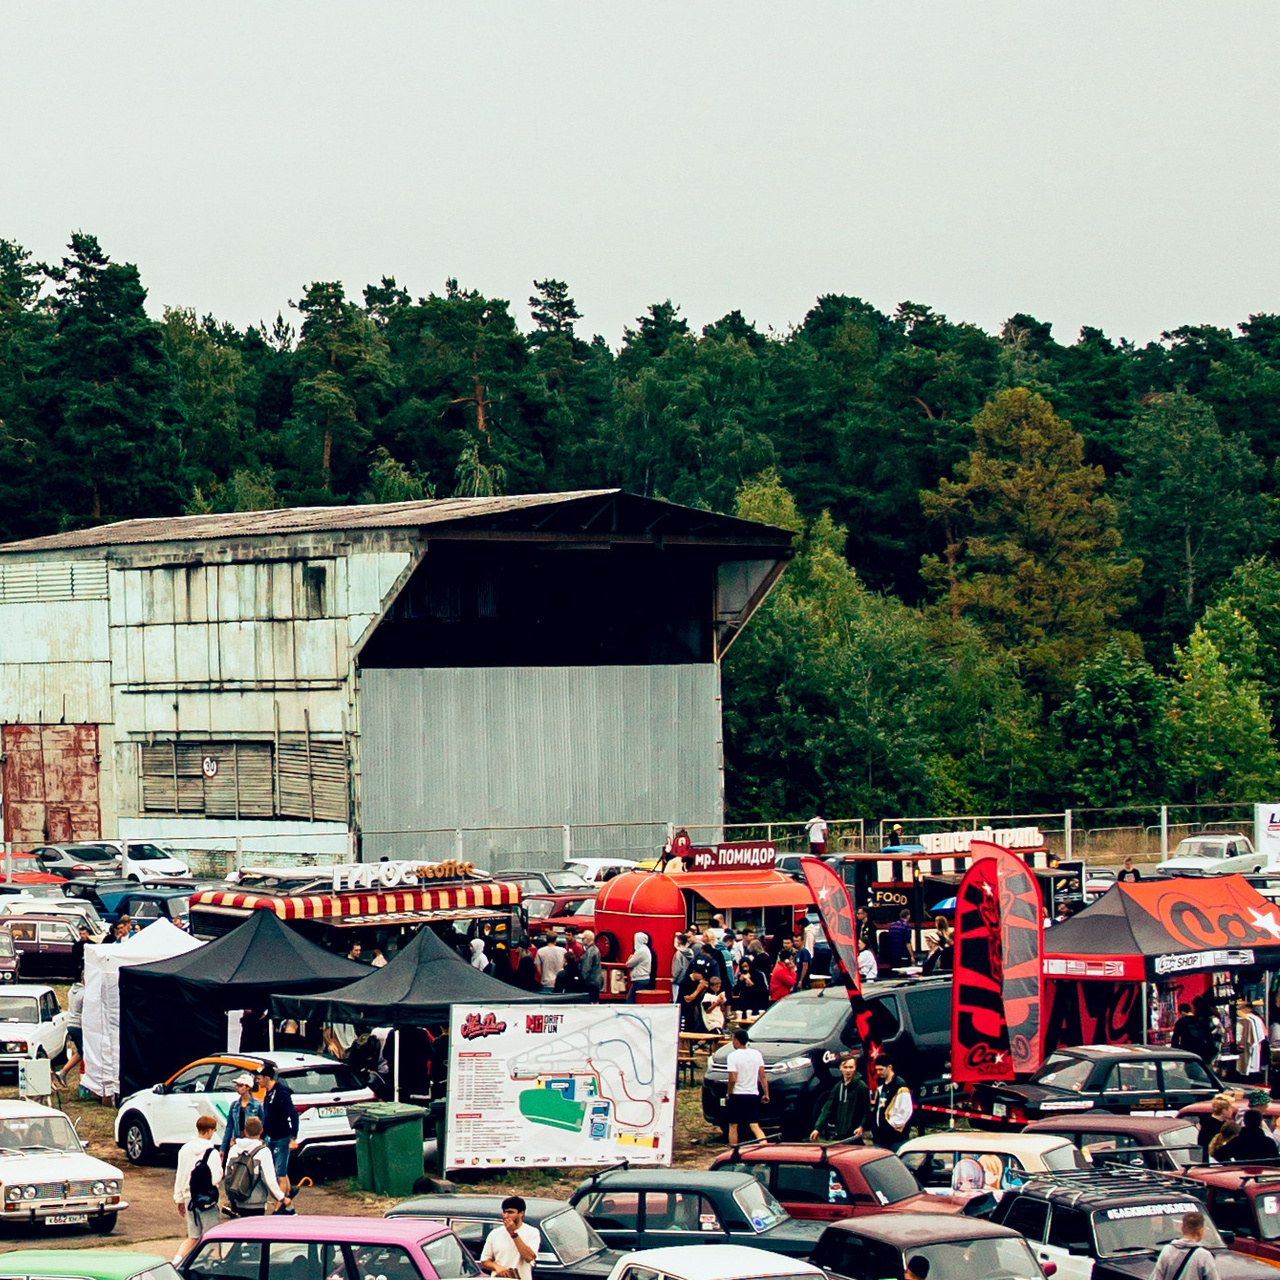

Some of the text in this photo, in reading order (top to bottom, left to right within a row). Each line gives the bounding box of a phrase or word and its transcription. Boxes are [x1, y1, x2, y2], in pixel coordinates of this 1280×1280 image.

[695, 847, 776, 870] мр. ПОМИДОР
[332, 865, 419, 891] ГИРОС
[876, 891, 908, 906] FOOD
[1177, 955, 1198, 969] SHOP
[544, 1024, 558, 1034] FUN
